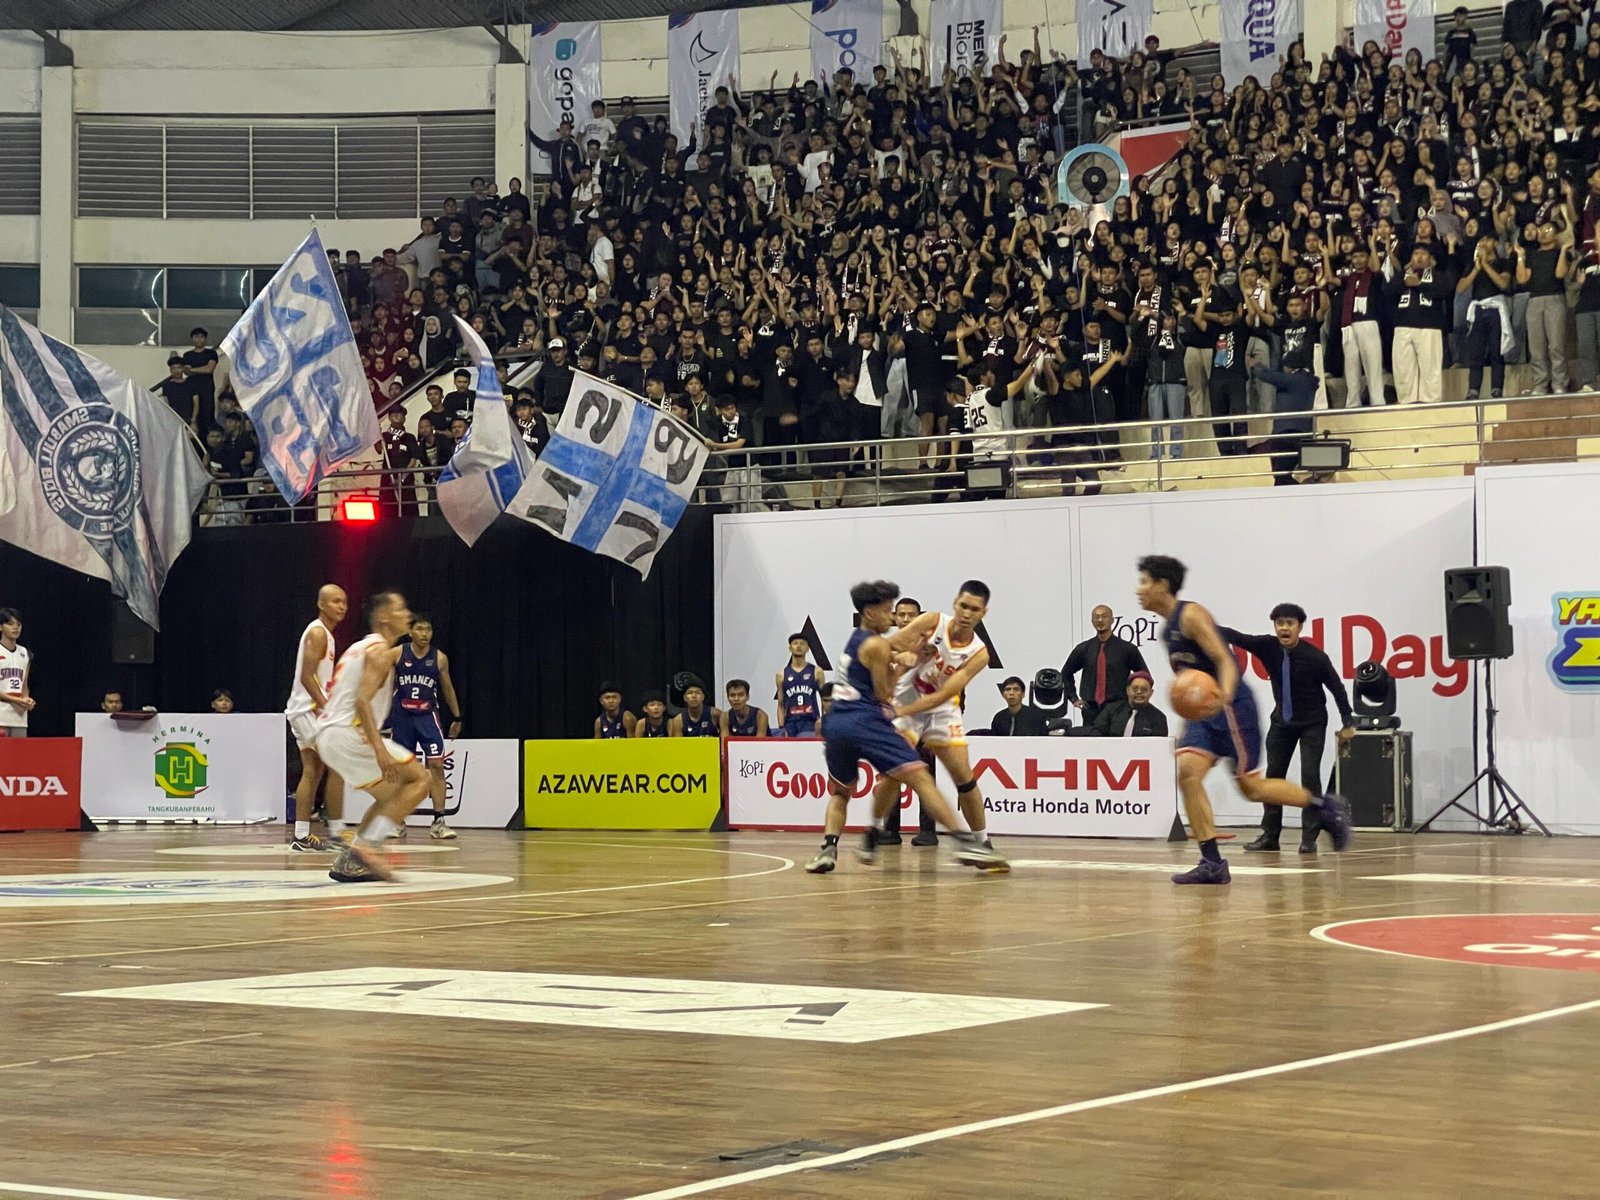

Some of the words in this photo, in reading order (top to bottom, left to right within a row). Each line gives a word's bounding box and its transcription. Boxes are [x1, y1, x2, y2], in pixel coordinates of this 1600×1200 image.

[971, 405, 988, 428] 25
[1341, 614, 1470, 698] Day
[10, 679, 20, 690] 32
[411, 687, 420, 699] 2
[797, 695, 804, 706] 9
[152, 725, 211, 746] HERMINA
[430, 743, 439, 755] 2
[537, 773, 707, 794] AZAWEAR.COM
[766, 761, 843, 799] Goo
[972, 758, 1150, 792] AHM
[148, 805, 216, 813] TANGKUBANPERAHU
[983, 797, 1026, 813] Astra
[1033, 798, 1089, 814] Honda
[1096, 799, 1151, 815] Motor
